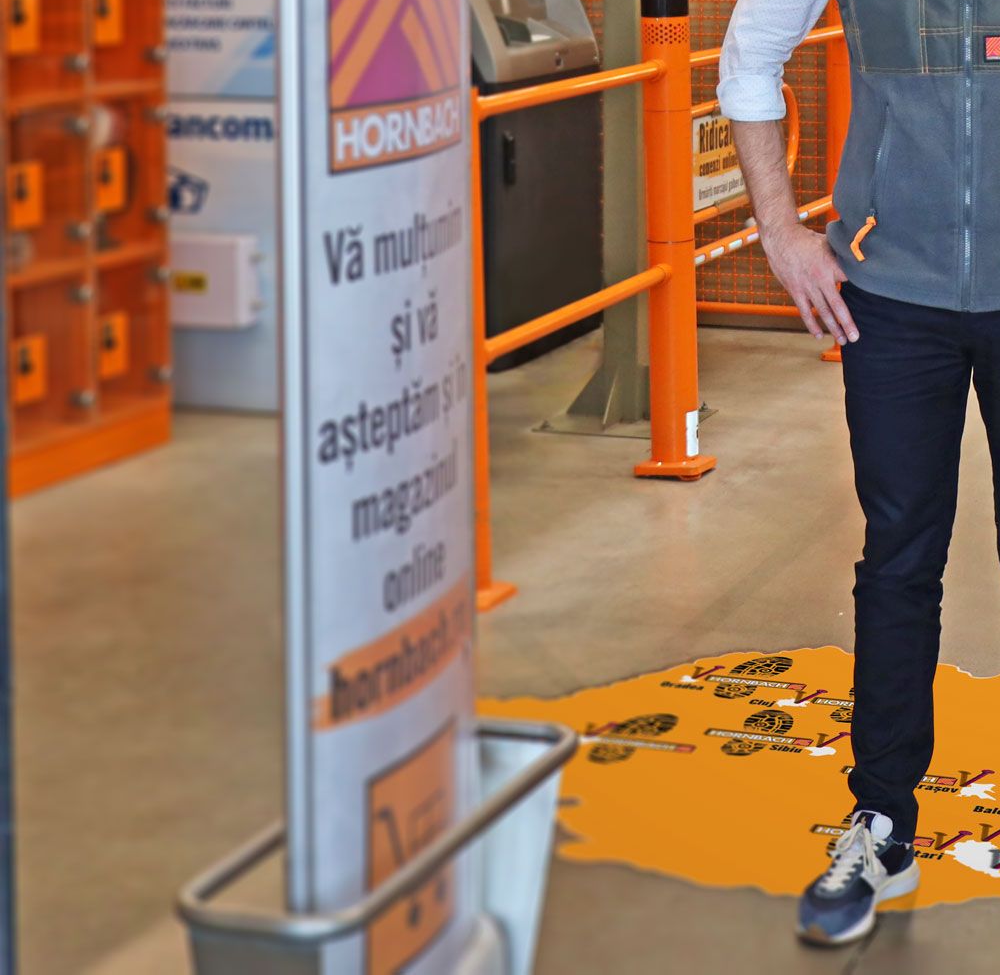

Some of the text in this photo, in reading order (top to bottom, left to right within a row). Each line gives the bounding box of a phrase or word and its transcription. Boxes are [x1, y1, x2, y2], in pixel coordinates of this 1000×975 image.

[167, 114, 274, 142] ancom
[335, 99, 460, 164] HORNBACH
[323, 223, 364, 287] Vă
[391, 289, 439, 368] și vă
[317, 376, 439, 472] așteptăm
[352, 436, 458, 542] magazinul
[383, 541, 446, 613] online
[708, 676, 789, 689] HORNBACH
[749, 697, 855, 708] Cluj HORN
[709, 730, 795, 744] HORNBACH
[769, 744, 803, 754] Sibiu
[915, 783, 959, 794] rașov
[914, 851, 945, 861] tari
